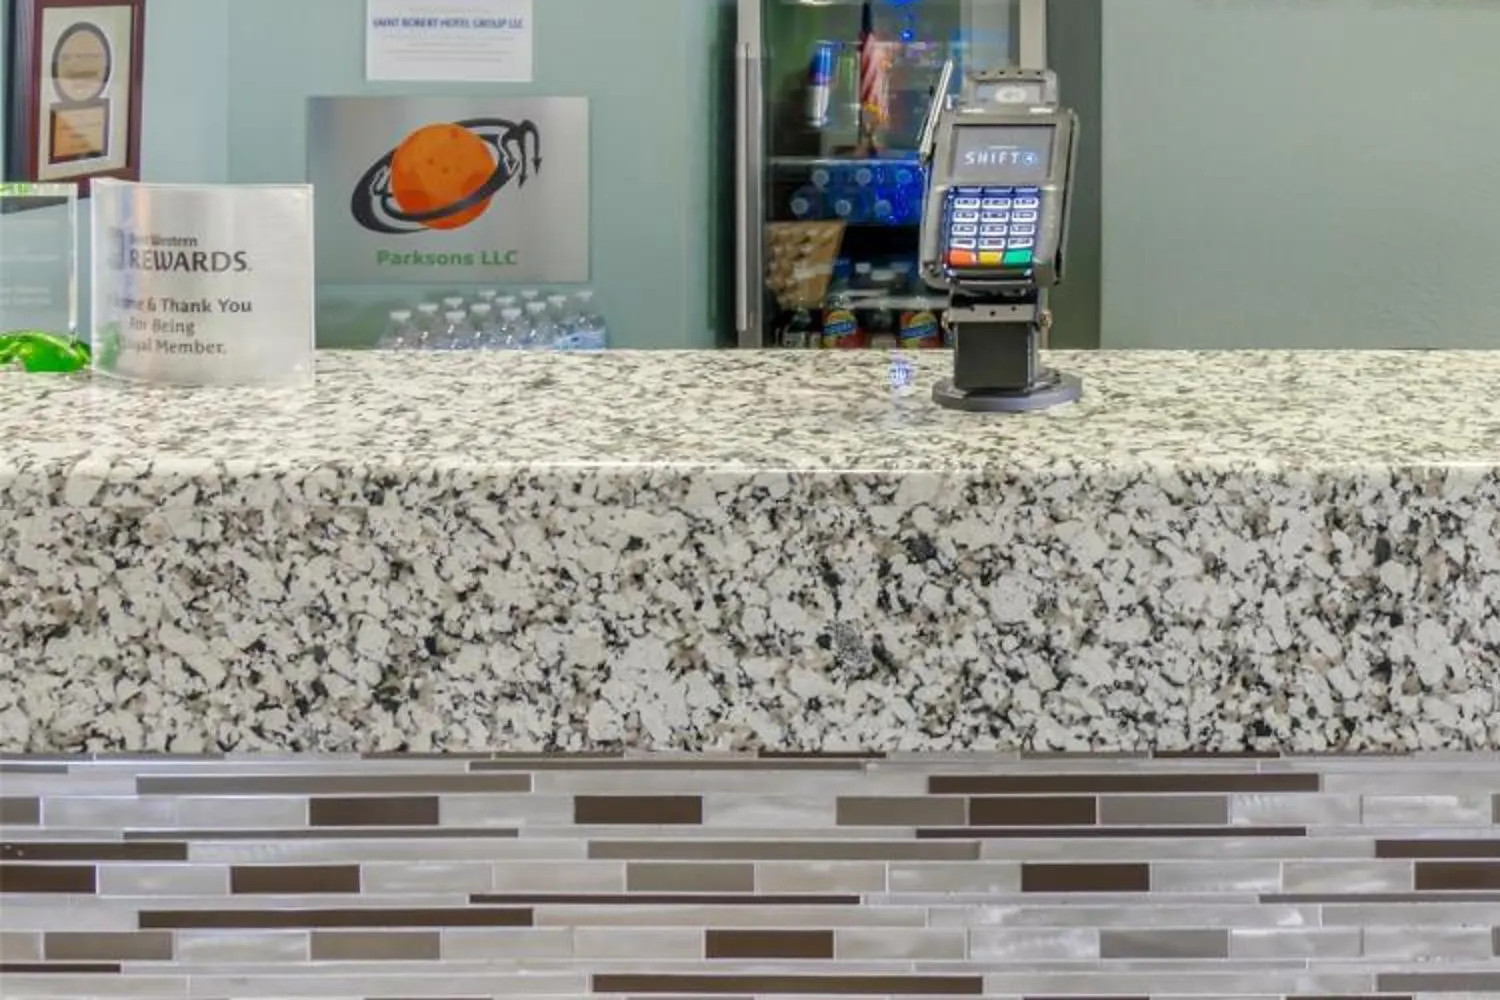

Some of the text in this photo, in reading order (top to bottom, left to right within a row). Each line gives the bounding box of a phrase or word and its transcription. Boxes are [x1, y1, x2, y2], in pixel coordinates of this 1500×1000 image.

[401, 18, 438, 28] ROBERT
[440, 18, 470, 28] HOTEL
[472, 18, 507, 28] GROUP
[151, 235, 198, 248] Western
[129, 249, 249, 272] REWARDS
[376, 249, 518, 265] Parksons LLC
[160, 297, 213, 313] Thank
[217, 298, 253, 313] You
[152, 318, 196, 336] Being
[155, 339, 228, 355] Member.
